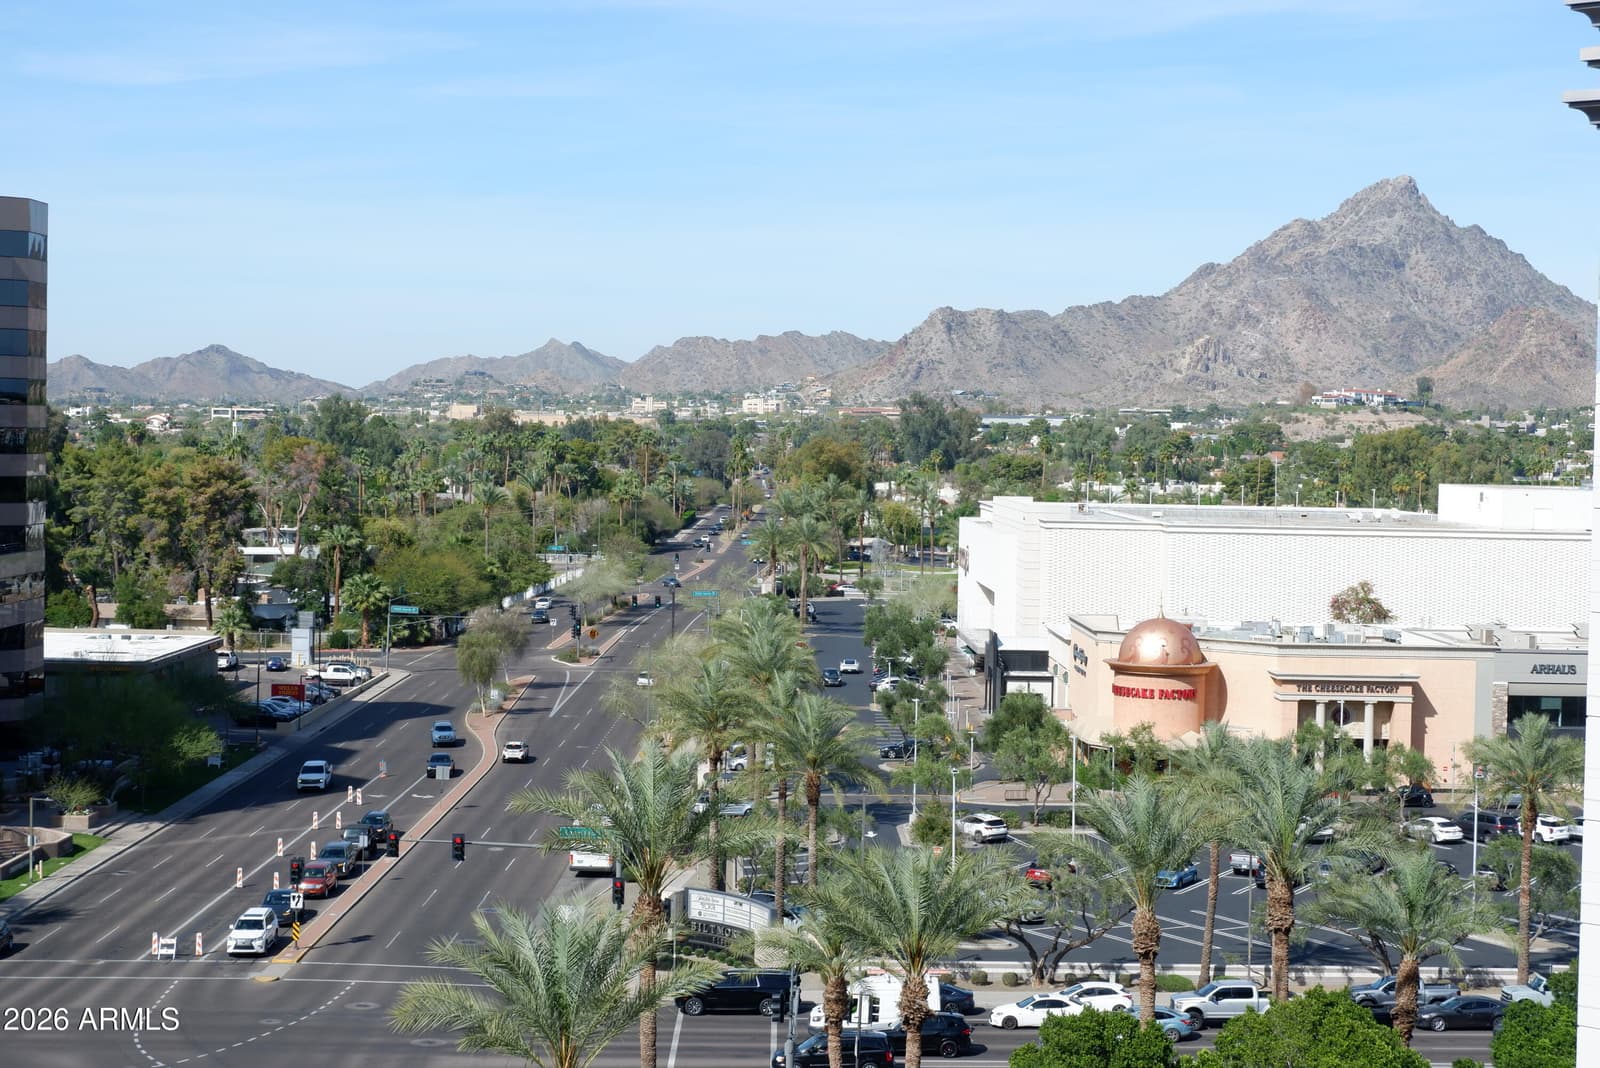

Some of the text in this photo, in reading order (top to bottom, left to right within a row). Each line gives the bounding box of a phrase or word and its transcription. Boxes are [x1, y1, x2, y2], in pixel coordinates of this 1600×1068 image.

[1530, 664, 1576, 674] ARHAUS
[1296, 684, 1399, 694] THE CHEESECAKE FACTORY
[690, 921, 738, 939] BILTMOR
